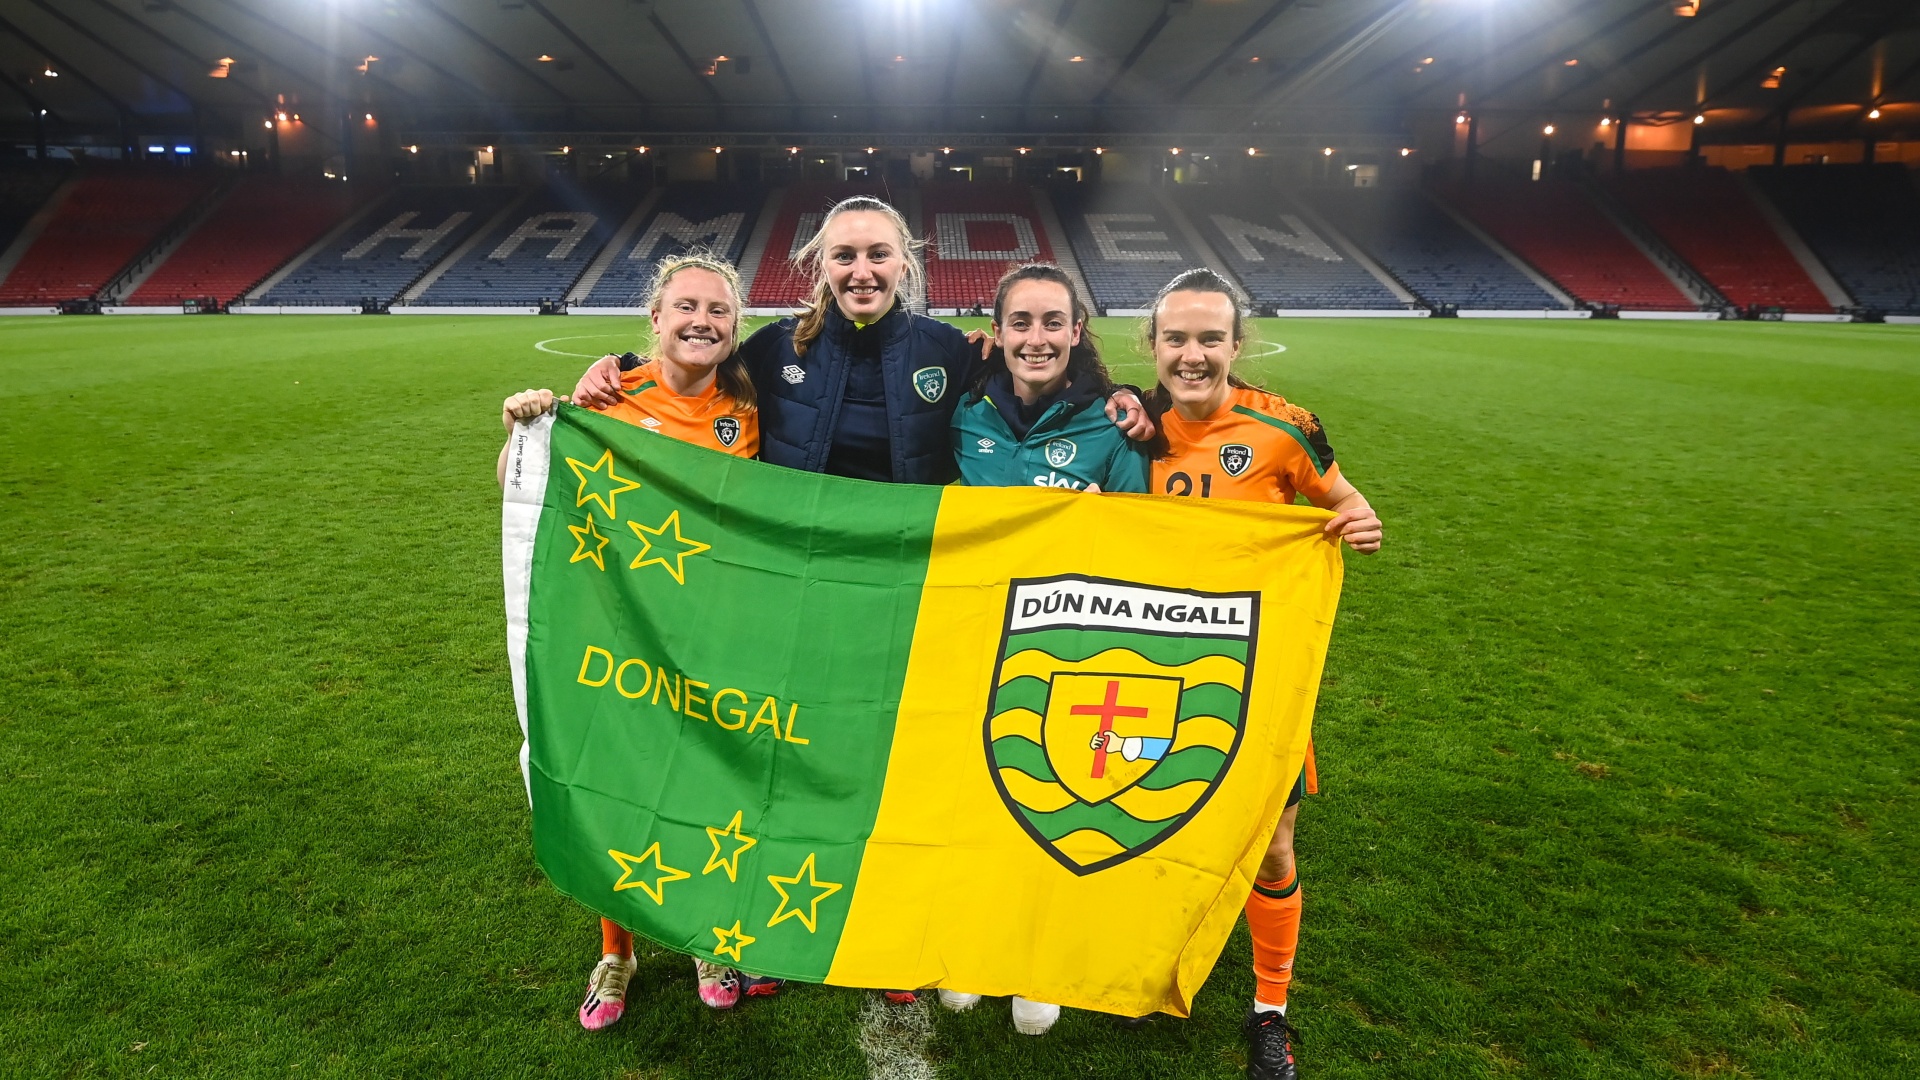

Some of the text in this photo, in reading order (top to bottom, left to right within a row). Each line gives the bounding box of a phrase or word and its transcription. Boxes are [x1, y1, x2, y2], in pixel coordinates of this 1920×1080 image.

[816, 136, 1007, 146] SCOTLAND SCOTLAND SCOTLAND
[343, 211, 1343, 263] HAMDEN
[918, 370, 940, 381] Ireland
[1053, 441, 1071, 451] Ireland
[1227, 447, 1247, 455] Ireland
[1166, 471, 1212, 498] 21
[1021, 590, 1245, 625] DÚN NA NGALL
[577, 645, 810, 745] DONEGAL
